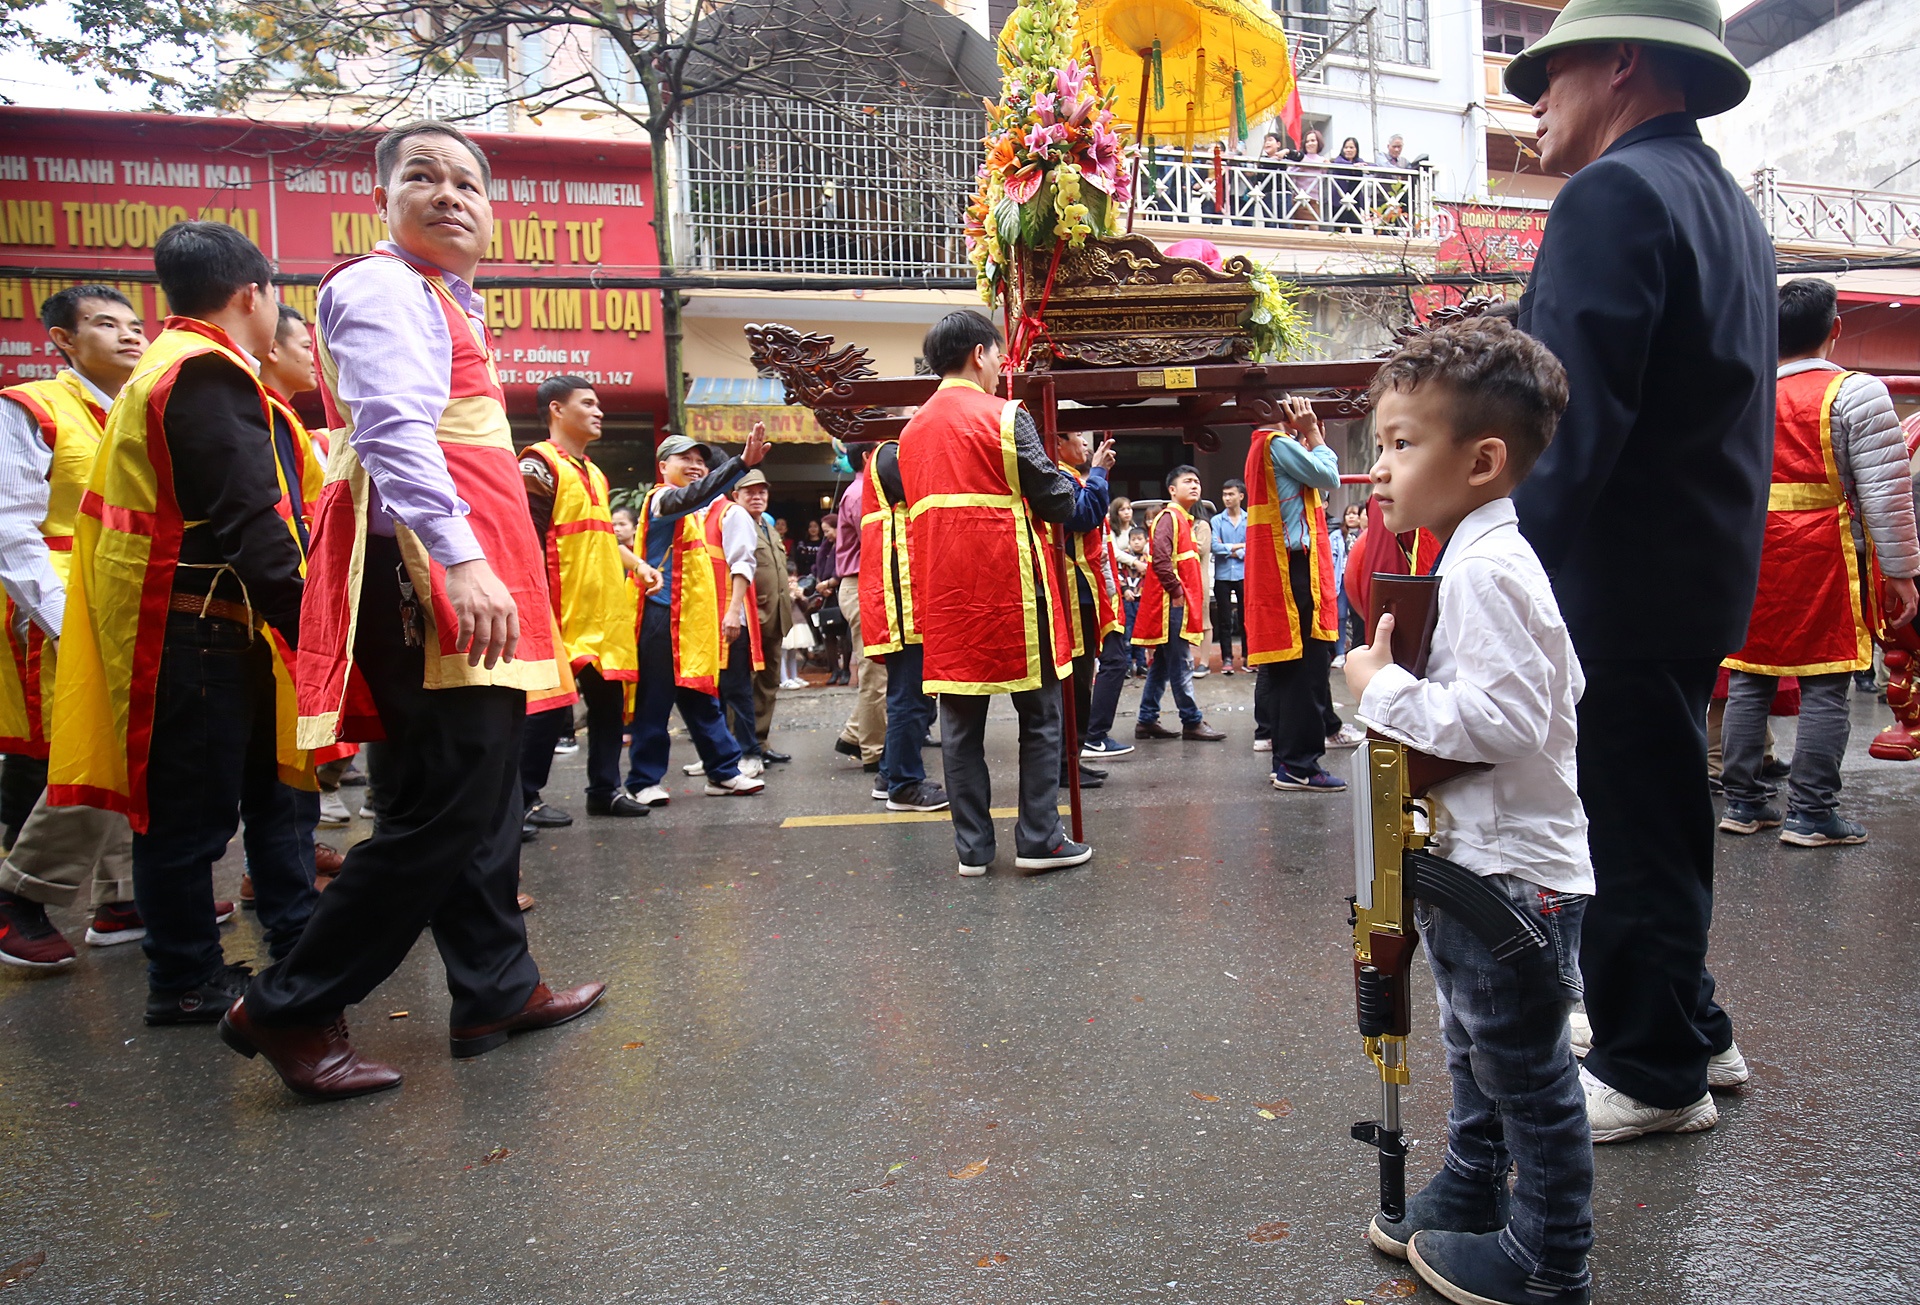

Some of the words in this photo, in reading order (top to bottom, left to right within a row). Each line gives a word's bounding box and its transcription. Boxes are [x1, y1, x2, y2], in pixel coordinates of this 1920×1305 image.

[33, 157, 115, 185] THANH
[121, 157, 200, 188] THÀNH
[205, 164, 251, 190] MAI
[284, 166, 327, 194] CÔNG
[329, 170, 347, 194] TY
[352, 161, 373, 195] CỔ
[511, 175, 537, 206] VẬT
[541, 179, 561, 204] TƯ
[565, 181, 644, 207] VINAMETAL
[1462, 211, 1496, 229] DOANH
[509, 211, 558, 269] VẬT
[565, 217, 604, 263] TƯ
[530, 287, 582, 331] KIM
[590, 289, 652, 340] LOẠI
